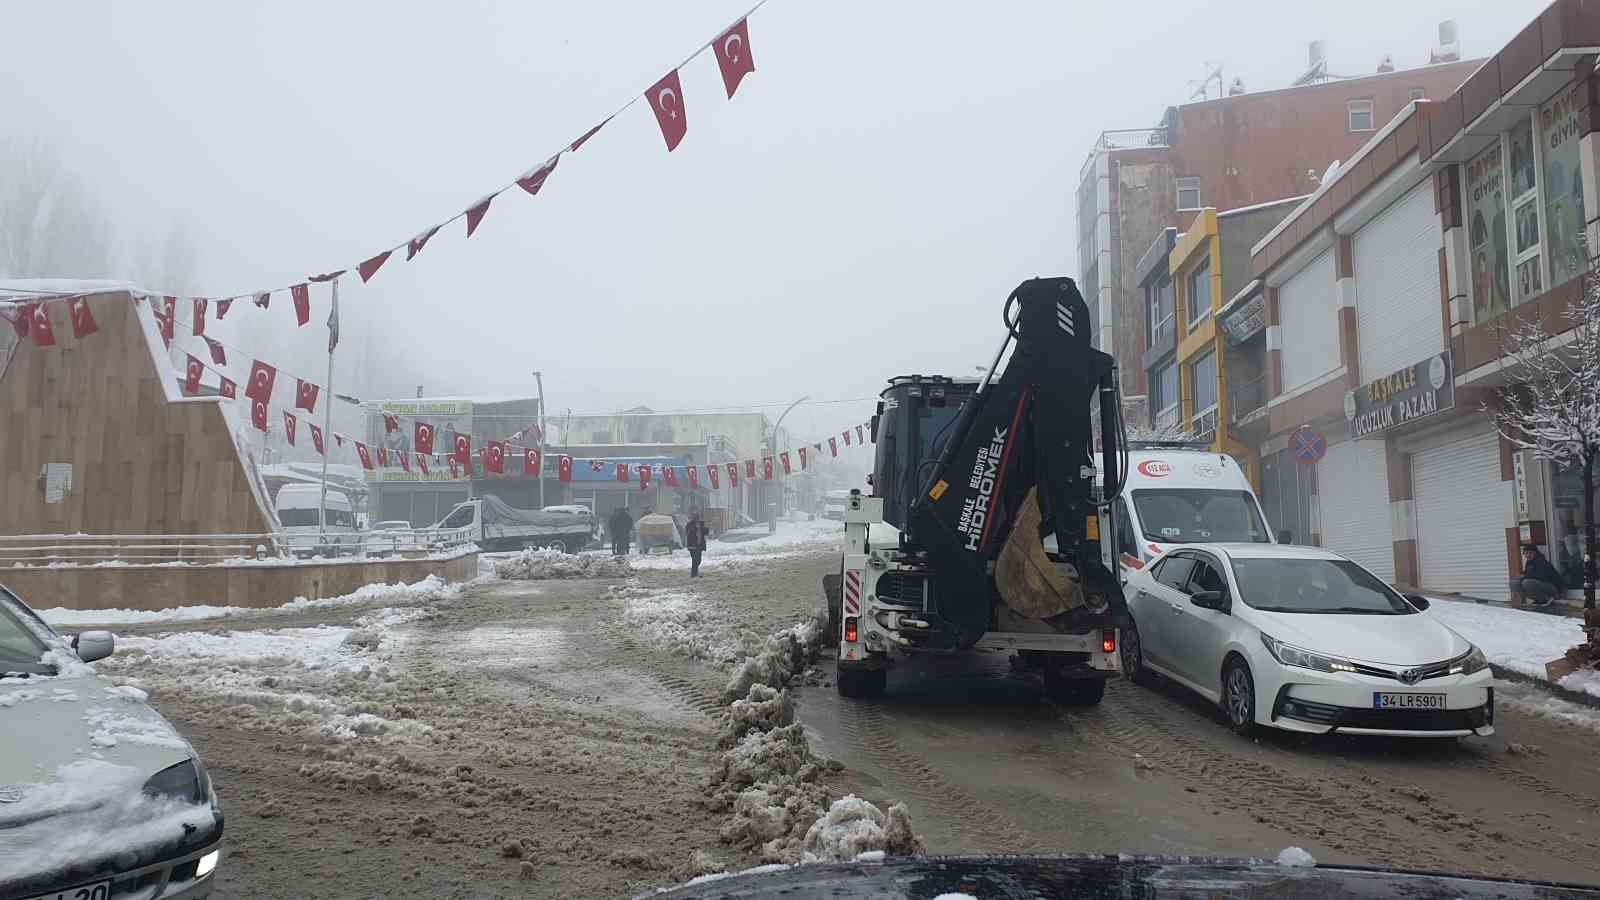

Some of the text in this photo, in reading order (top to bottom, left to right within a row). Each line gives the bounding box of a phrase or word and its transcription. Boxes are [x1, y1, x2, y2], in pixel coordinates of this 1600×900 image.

[1368, 367, 1417, 402] BAŞKALE
[1353, 390, 1438, 435] UCUZLUK PAZARI
[958, 447, 989, 533] BAŞKALE BELEDİYESİ
[964, 425, 1008, 551] HİDROMEK
[1382, 695, 1396, 706] 34
